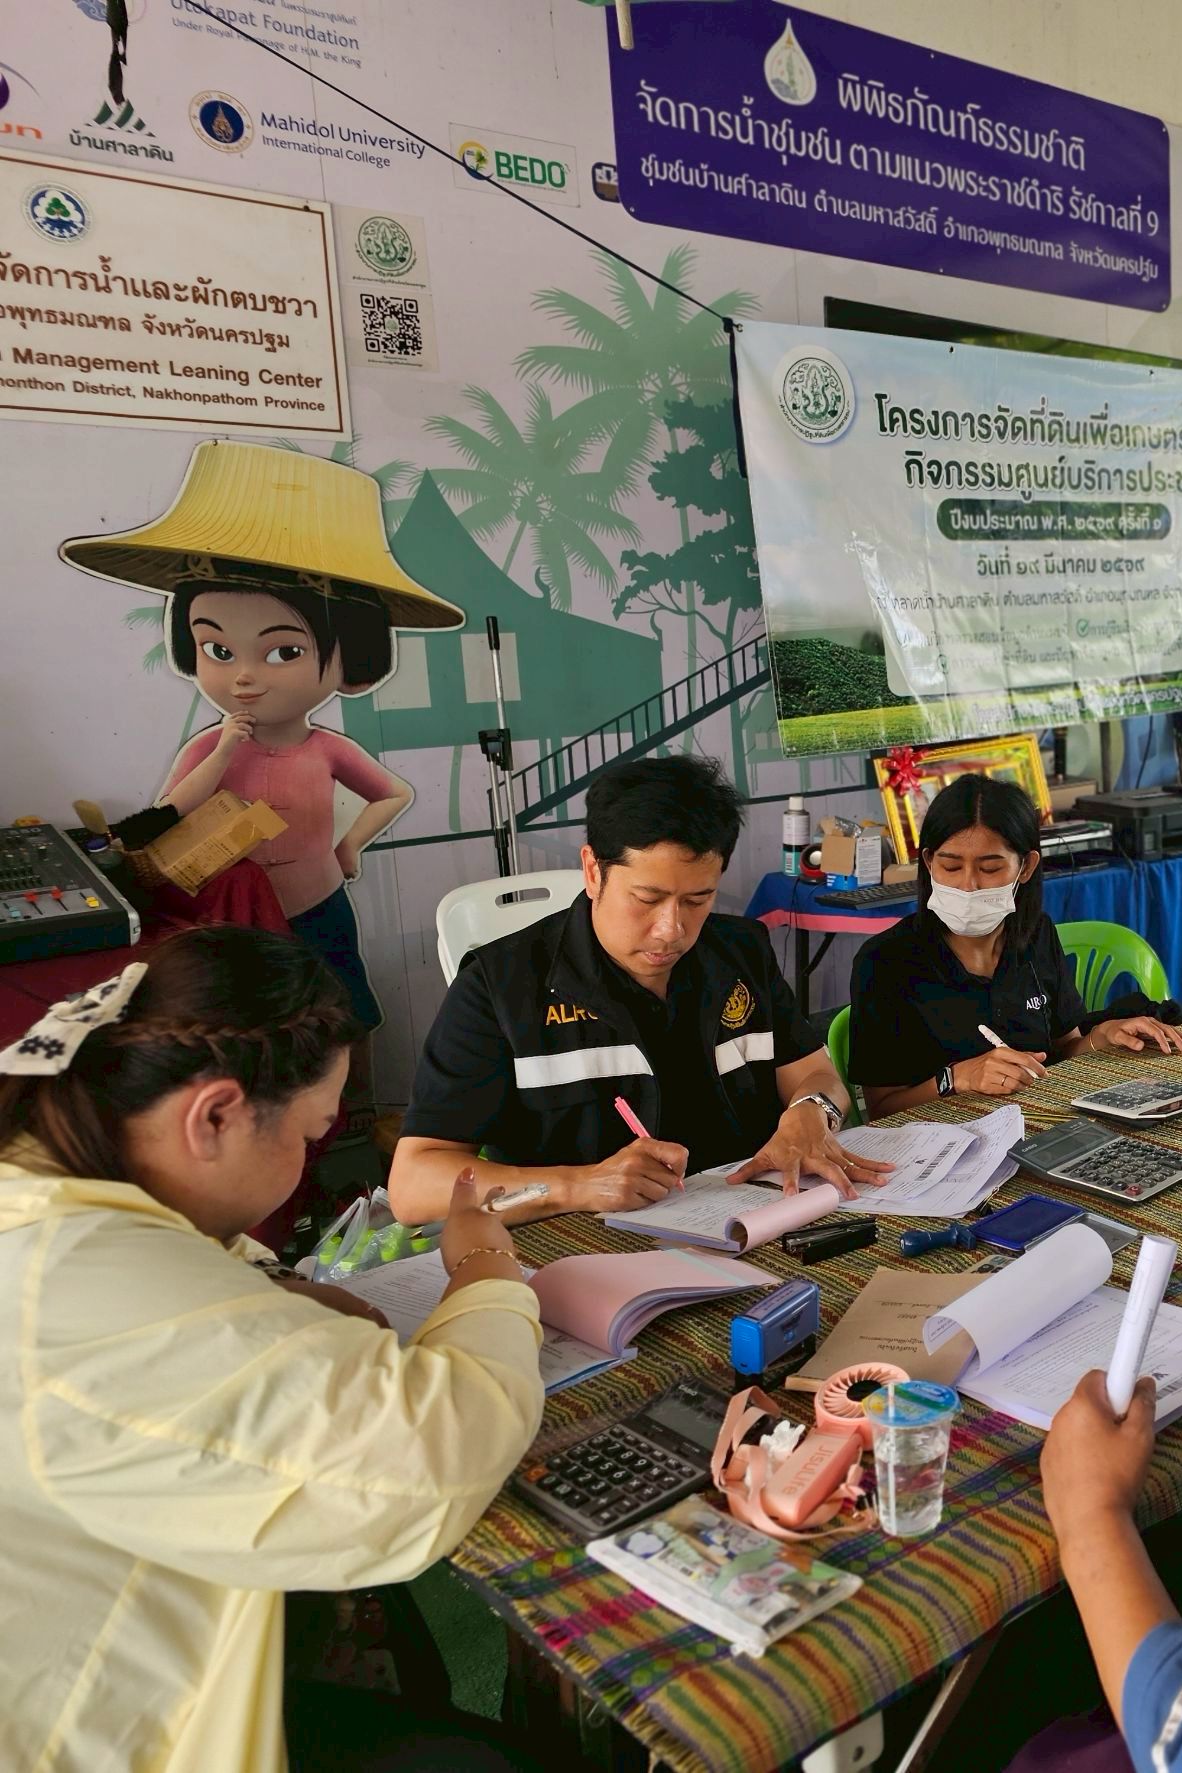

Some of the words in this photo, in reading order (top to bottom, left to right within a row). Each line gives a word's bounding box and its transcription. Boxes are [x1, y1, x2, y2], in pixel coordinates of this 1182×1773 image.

[263, 13, 360, 50] Foundation
[341, 54, 361, 69] King
[260, 112, 336, 140] Mahidol
[338, 126, 425, 159] University
[838, 73, 1085, 170] พิพิธภัณฑ์ธรรมชาติ
[69, 128, 174, 162] บ้านศาลาดิน
[262, 135, 344, 158] International
[345, 150, 391, 169] College
[636, 79, 842, 166] จัดการน้ำชุมชน
[849, 143, 1063, 216] ตามแนวพระราชดำริ
[1069, 186, 1142, 234] รัชกาลที่
[1147, 210, 1158, 236] 9
[494, 150, 566, 188] BEDO
[641, 154, 807, 208] ชุมชนบ้านศาลาดิน
[814, 189, 937, 235] ตำบลมหาสวัสดิ์
[944, 217, 1063, 261] อำเภอพุทธมณฑล
[1070, 242, 1158, 282] จังหวัดนครปฐม
[141, 313, 290, 352] จังหวัดนครปฐม
[12, 347, 160, 375] Management
[169, 360, 250, 386] Leaning
[259, 368, 323, 389] Center
[73, 380, 136, 399] District,
[143, 386, 258, 407] Nakhonpathom
[264, 396, 325, 412] Province
[950, 508, 1038, 531] ปีงบประมาณ
[1041, 513, 1072, 530] พ.ศ.
[977, 545, 1011, 576] วันที่
[1044, 552, 1097, 574] มีนาคม
[546, 1003, 598, 1026] ALR
